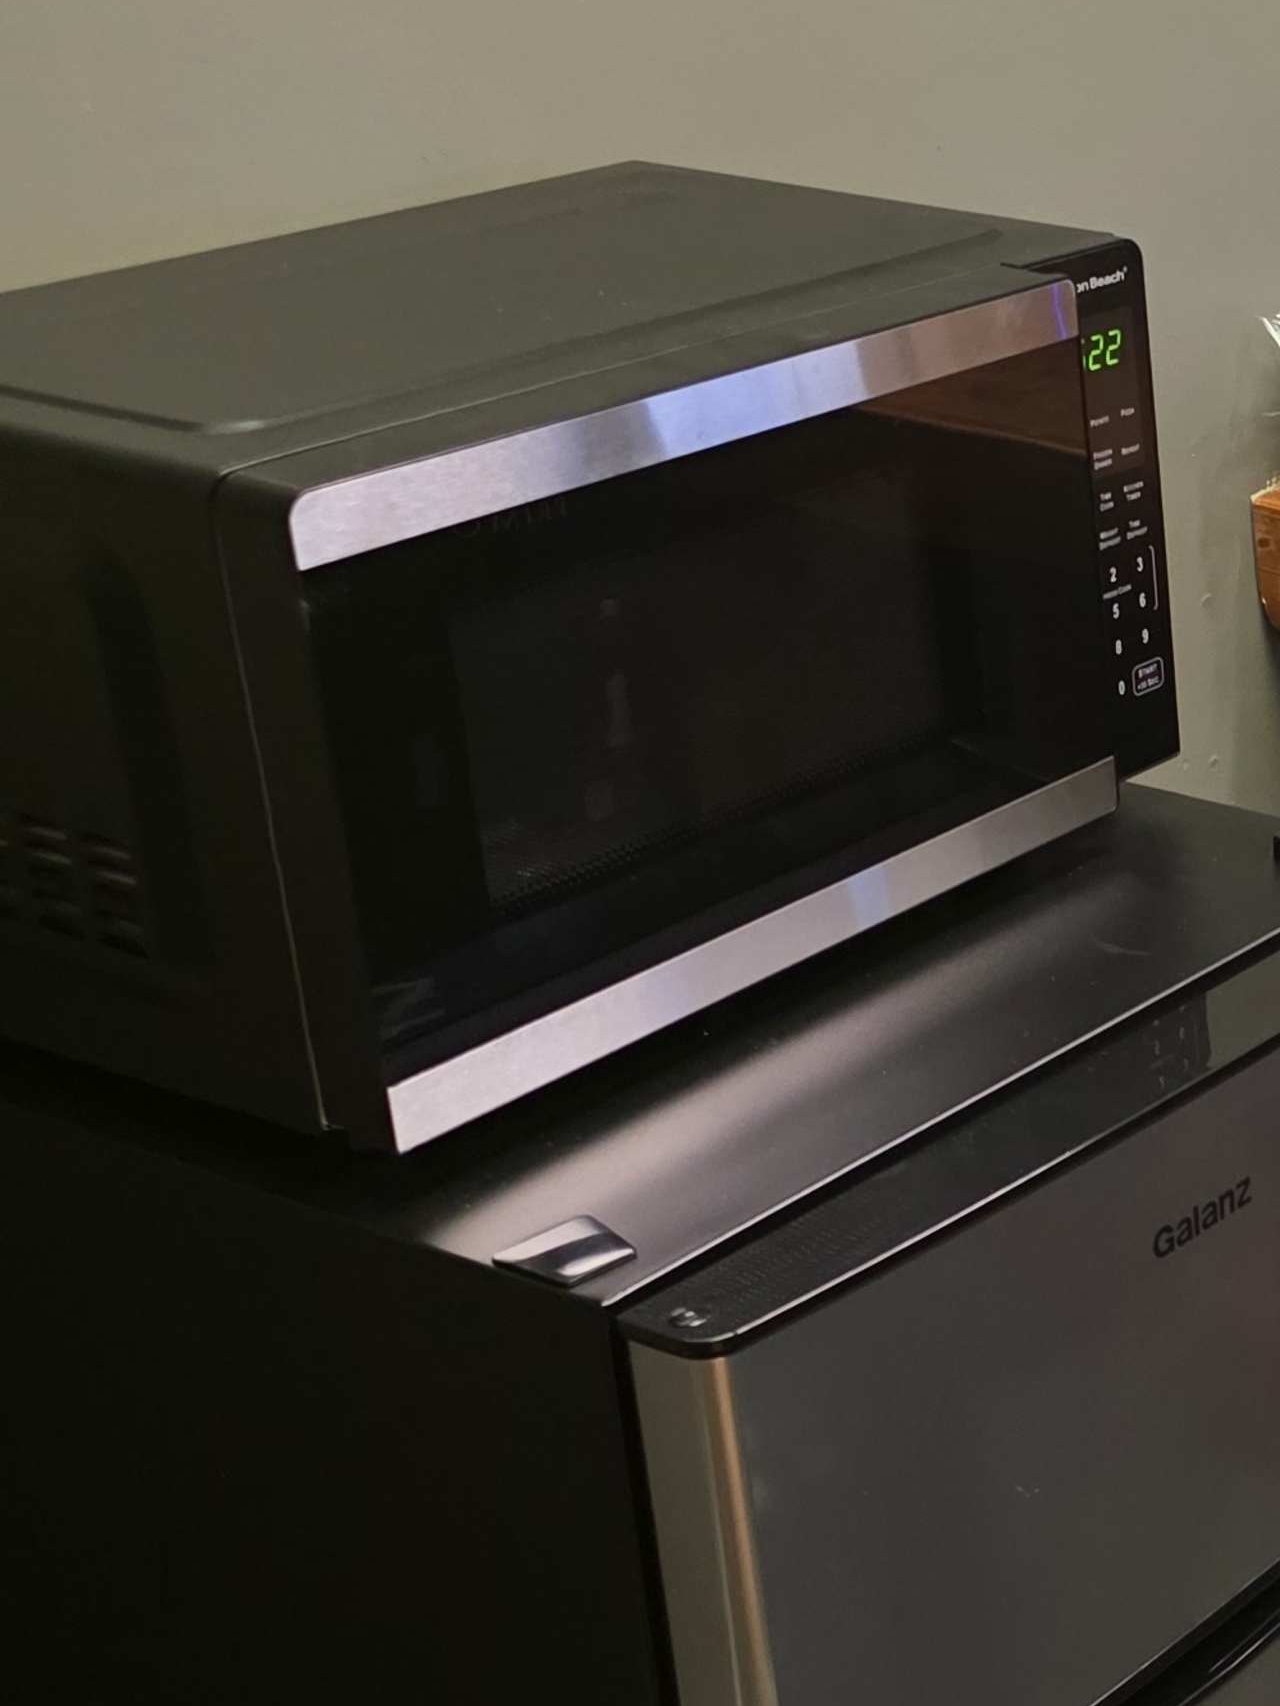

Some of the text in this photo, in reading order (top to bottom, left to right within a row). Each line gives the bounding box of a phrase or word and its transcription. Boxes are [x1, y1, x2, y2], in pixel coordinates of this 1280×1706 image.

[1082, 329, 1121, 371] 22
[1136, 556, 1143, 572] 3
[1109, 566, 1117, 583] 2
[1139, 592, 1146, 608] 6
[1113, 603, 1120, 619] 5
[1142, 628, 1149, 644] 9
[1115, 639, 1122, 654] 8
[1118, 680, 1125, 695] 0
[1152, 1176, 1253, 1258] Galanz
